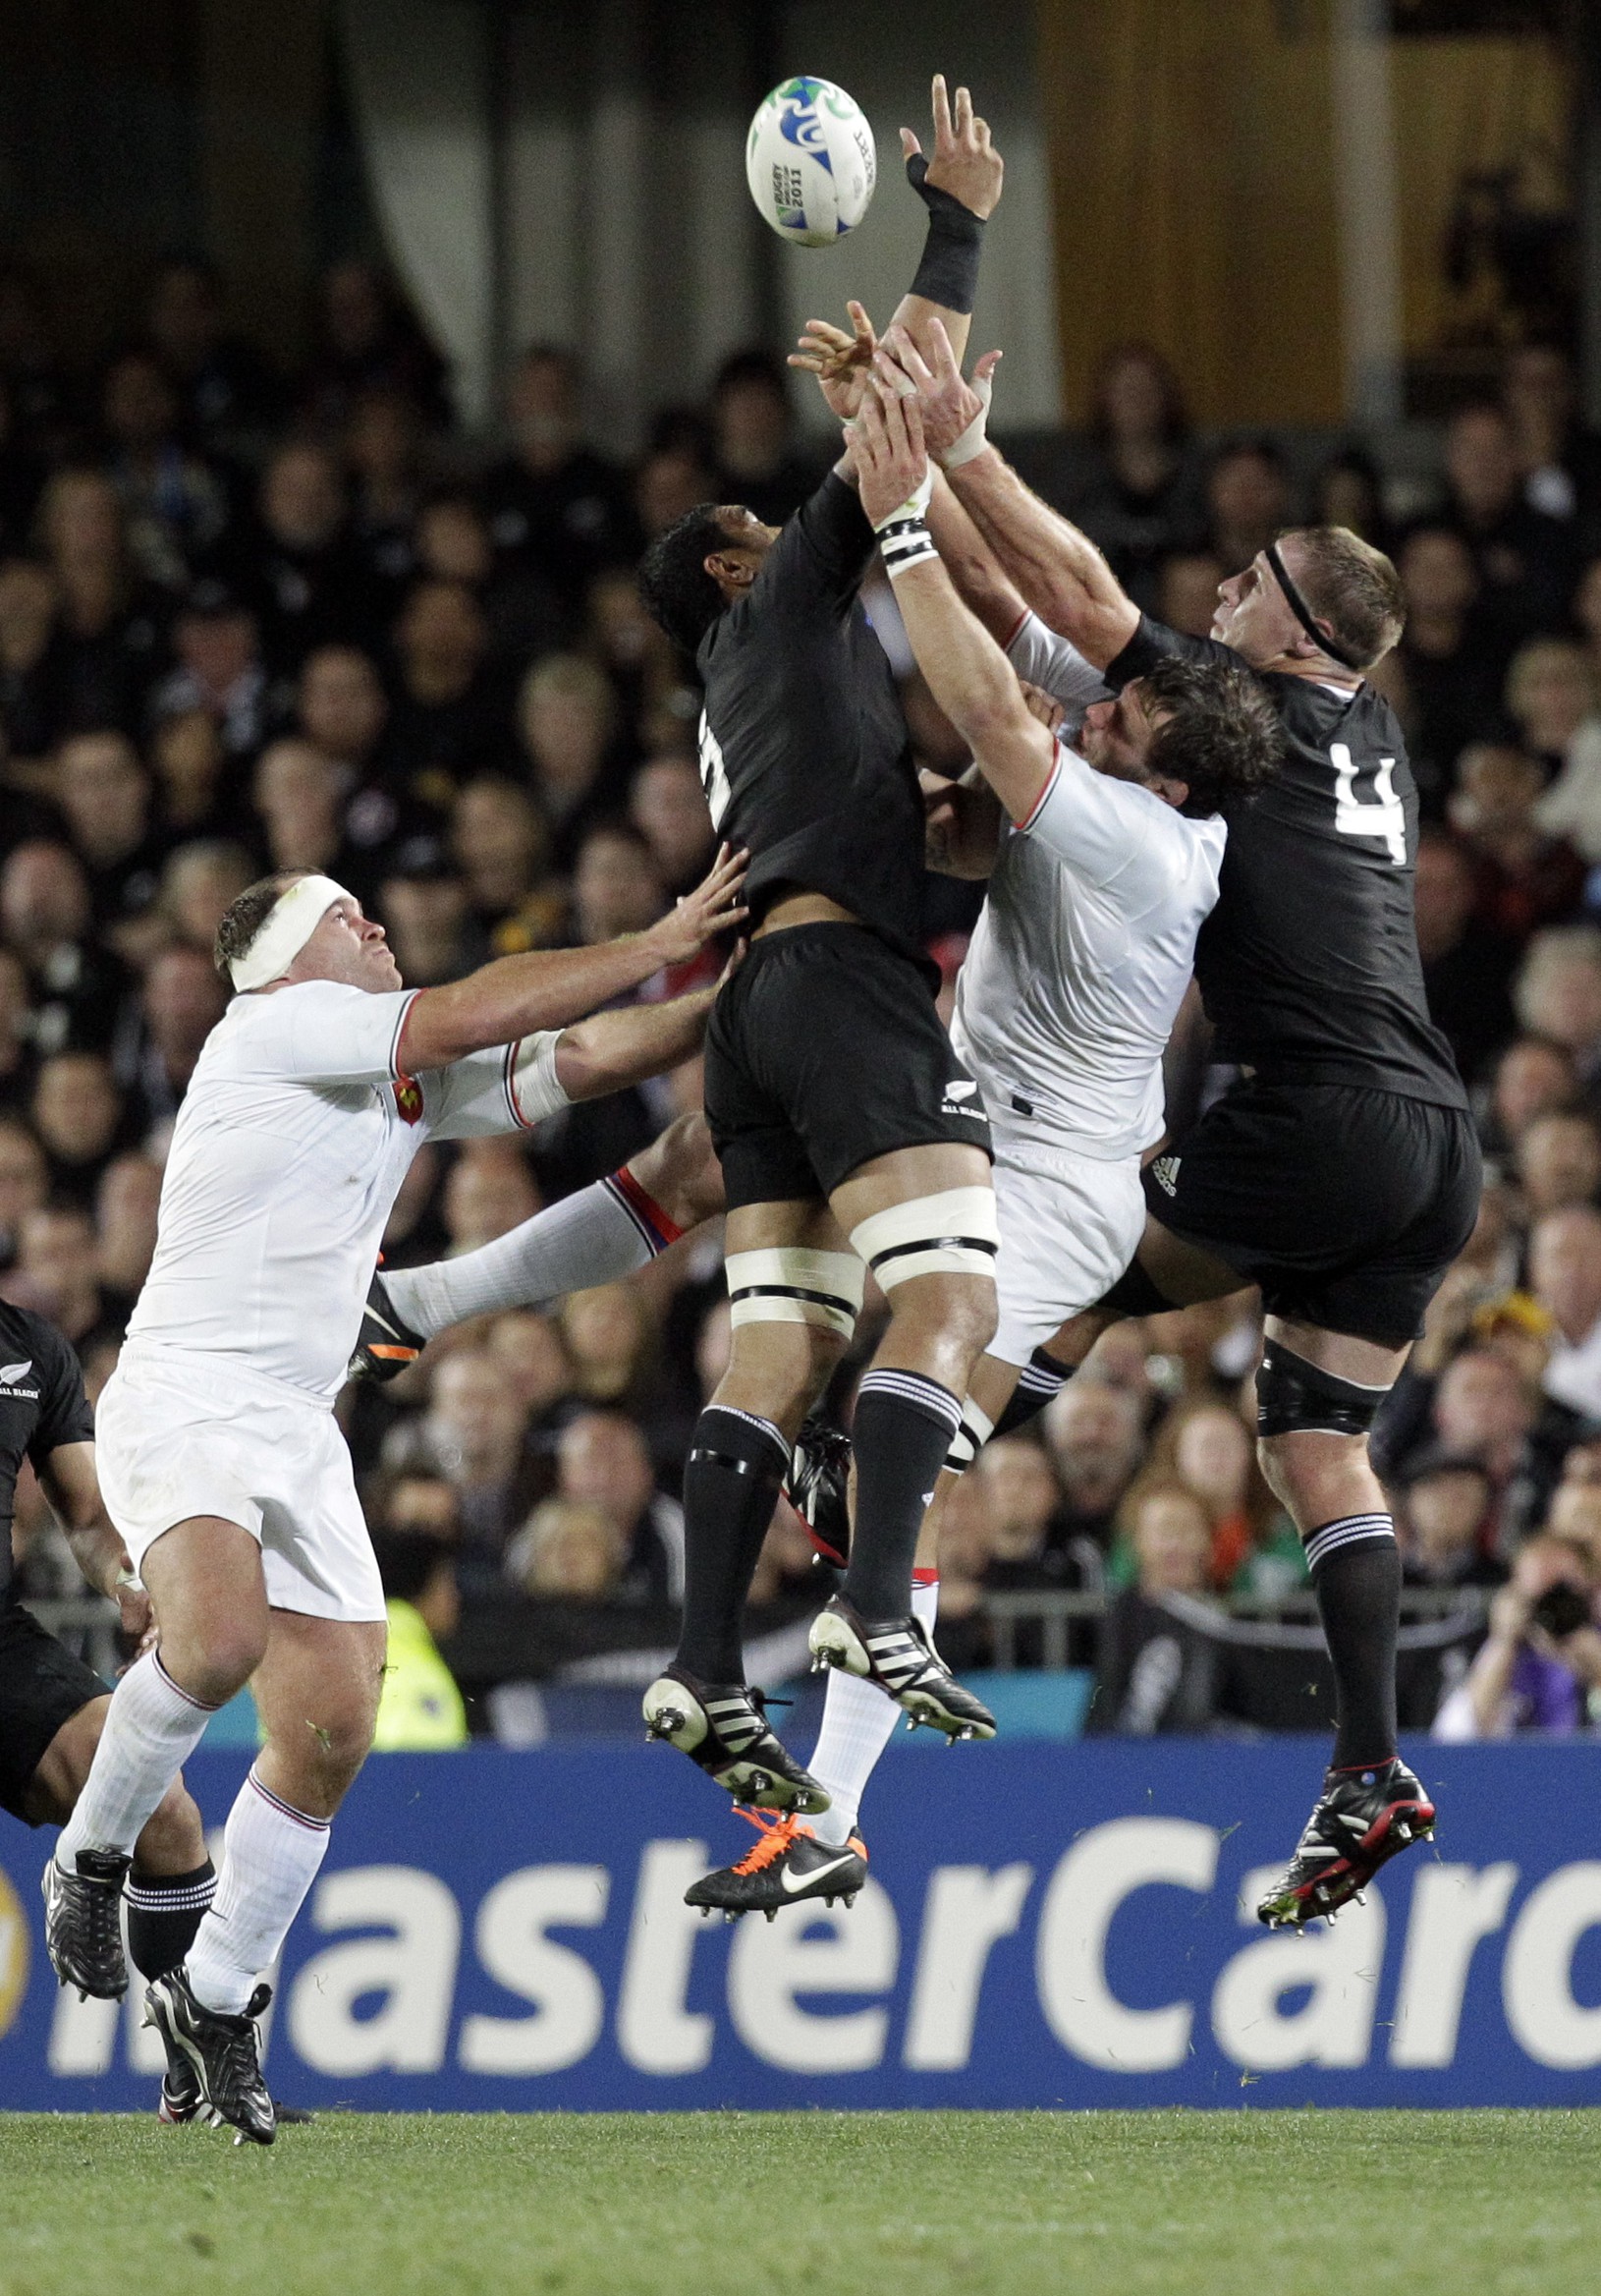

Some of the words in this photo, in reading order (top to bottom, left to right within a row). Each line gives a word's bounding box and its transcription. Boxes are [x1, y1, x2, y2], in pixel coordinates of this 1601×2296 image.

[773, 164, 784, 205] RUGBY
[792, 169, 803, 207] 2011
[1330, 743, 1406, 866] 4
